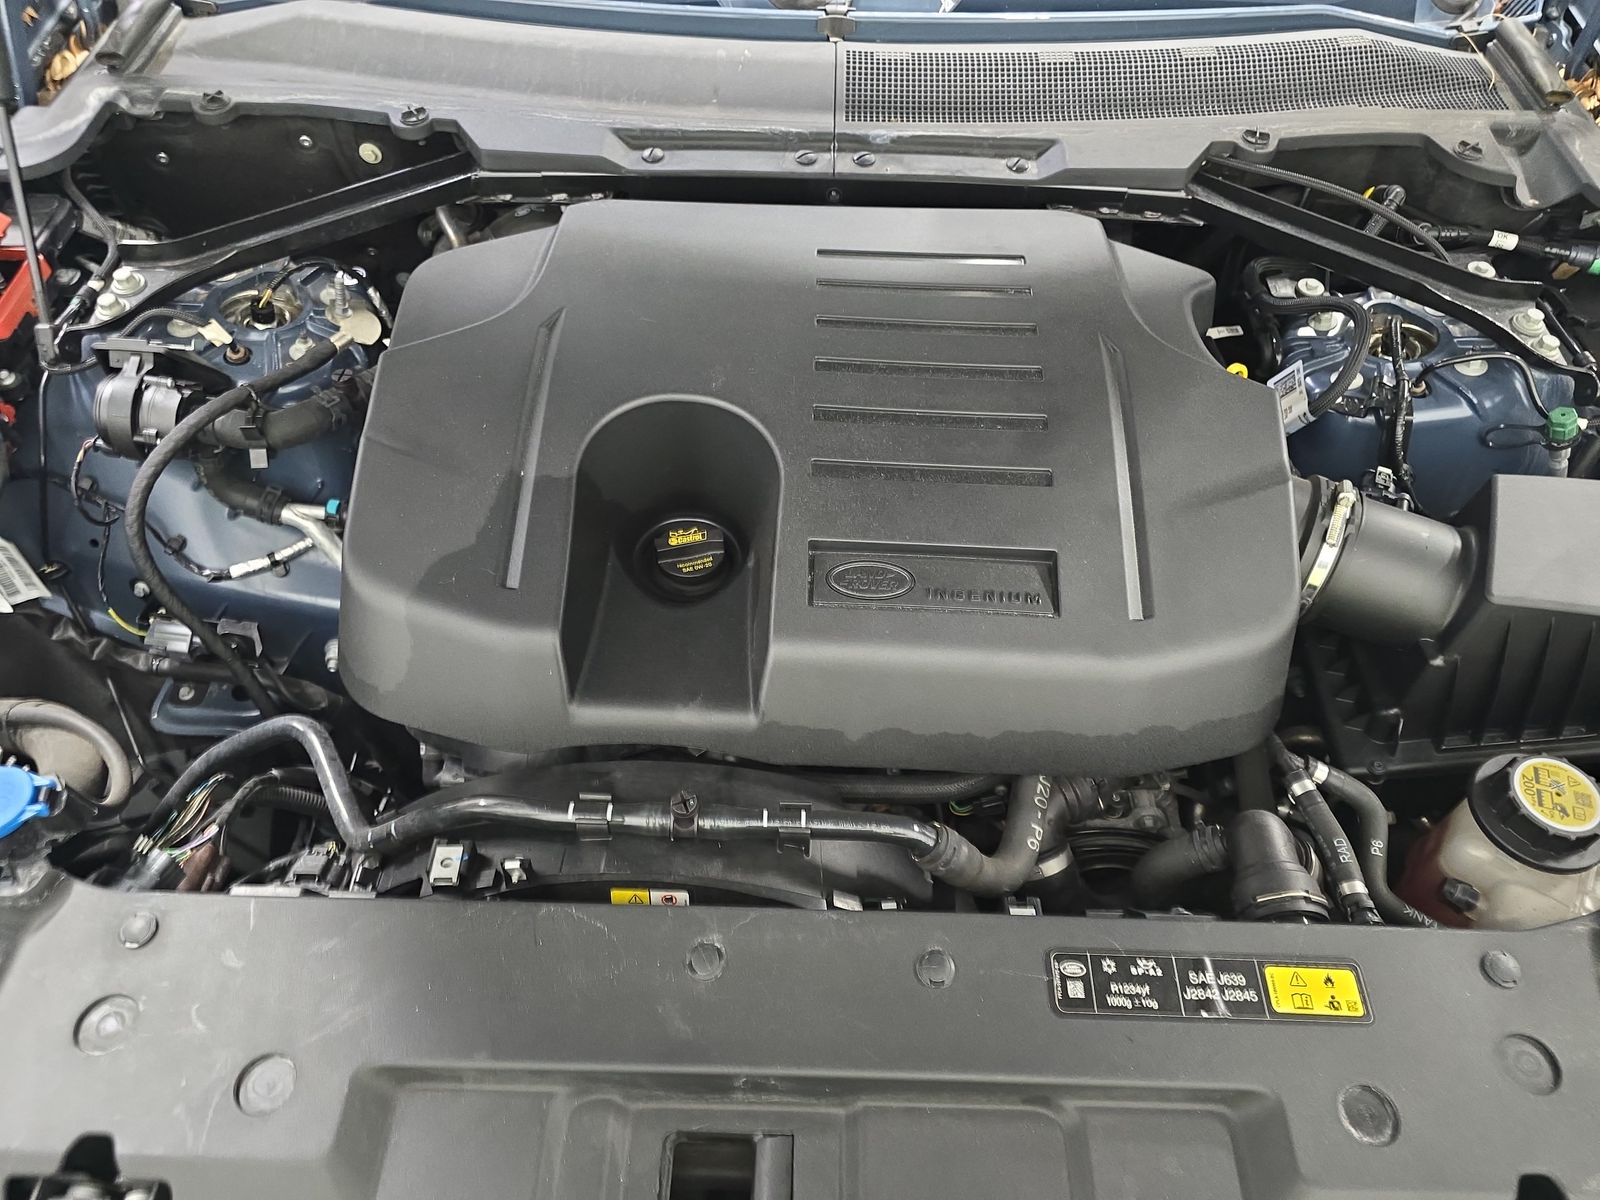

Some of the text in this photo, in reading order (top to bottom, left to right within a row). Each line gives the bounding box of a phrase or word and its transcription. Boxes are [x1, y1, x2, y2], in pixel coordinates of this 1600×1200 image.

[675, 532, 703, 546] Castrol
[926, 586, 1042, 605] INGENIUM
[1333, 838, 1352, 863] RAD
[1371, 840, 1384, 857] P6
[1188, 970, 1246, 987] SAE J639
[1110, 981, 1150, 997] R1234yf
[1183, 985, 1220, 1000] J2842
[1221, 988, 1258, 1003] J2845
[1106, 994, 1132, 1009] 1000g
